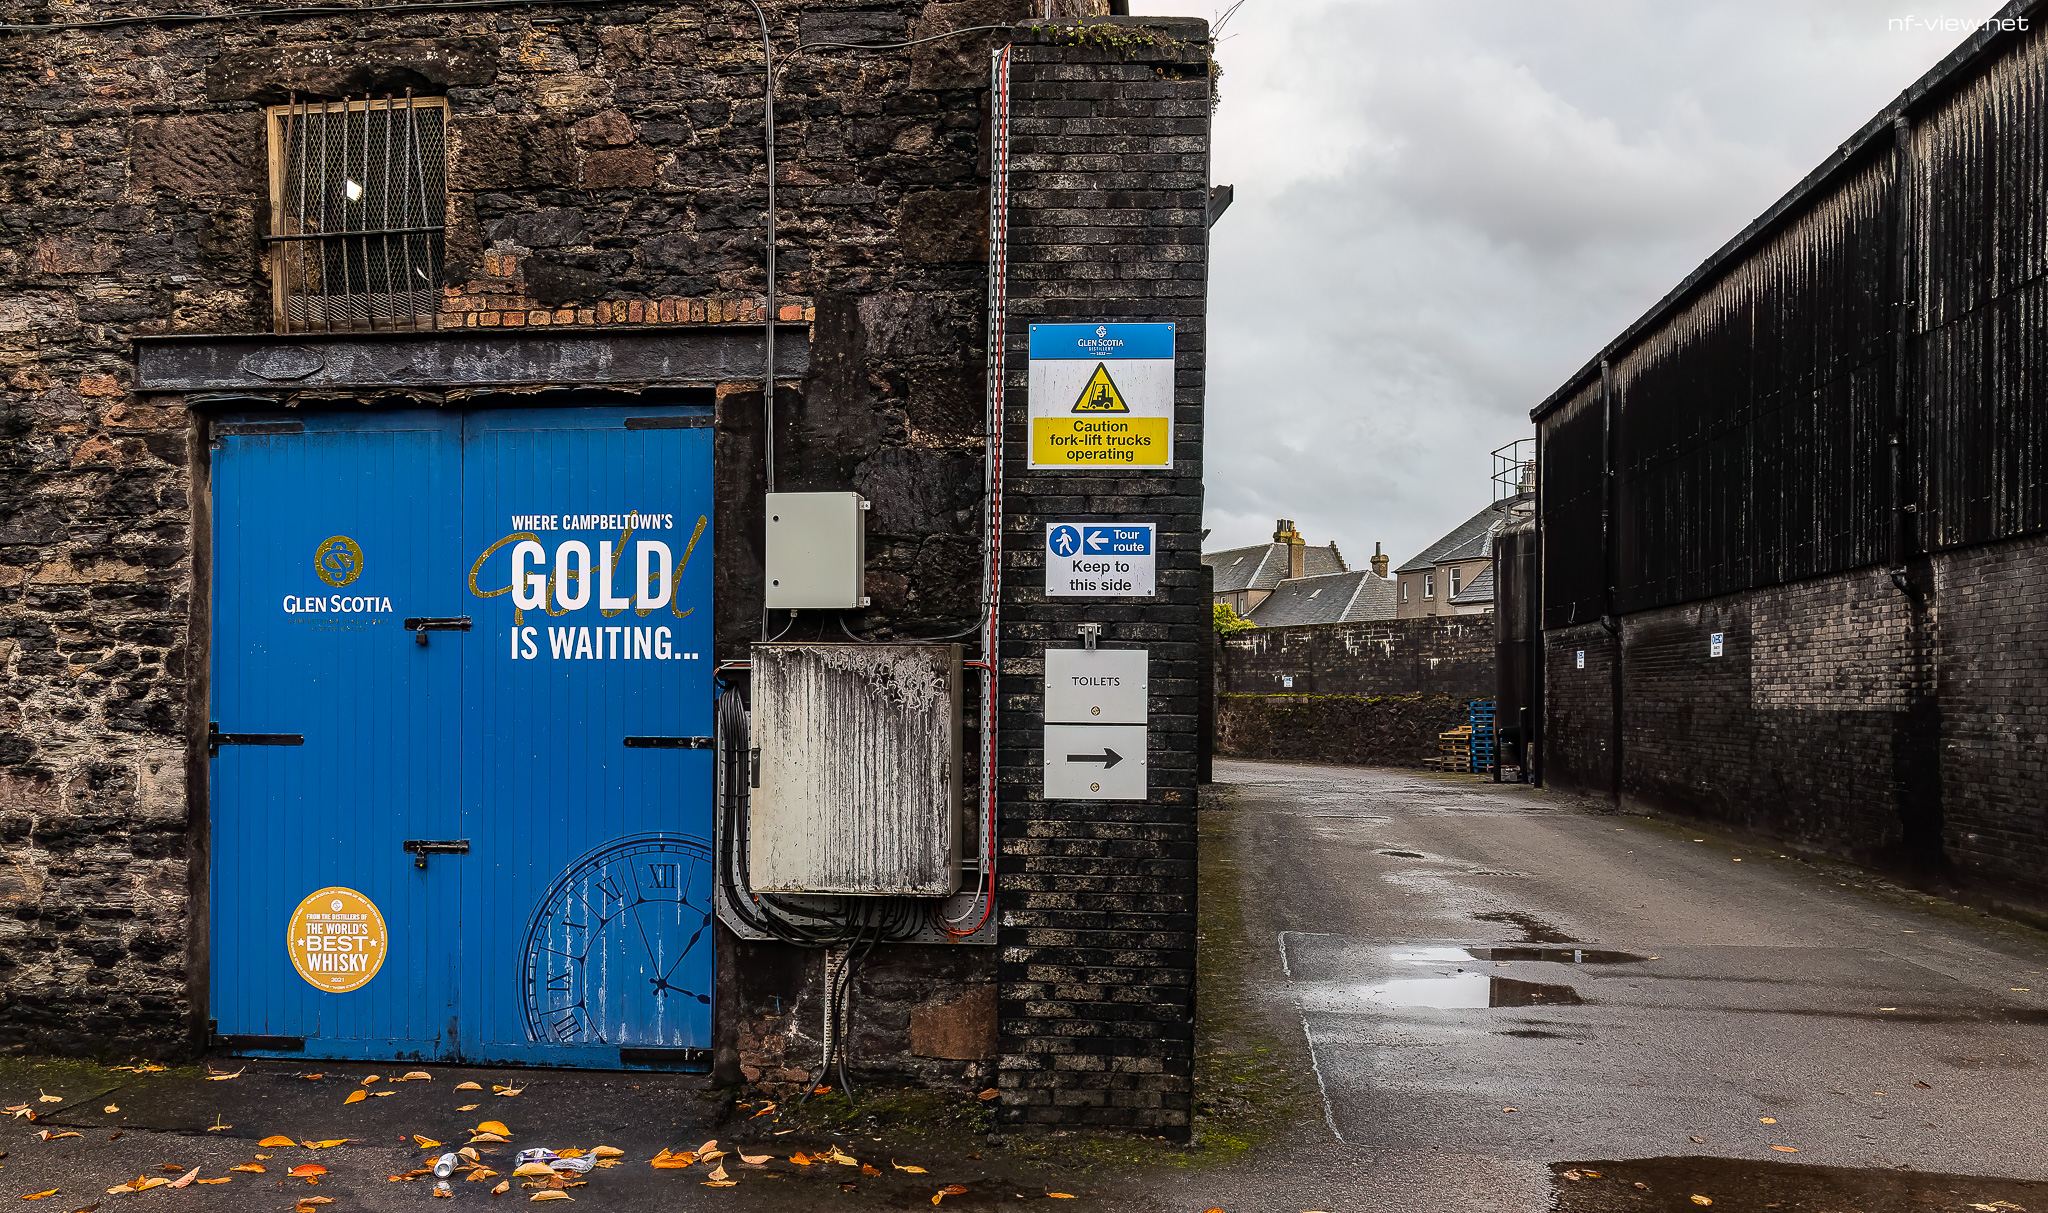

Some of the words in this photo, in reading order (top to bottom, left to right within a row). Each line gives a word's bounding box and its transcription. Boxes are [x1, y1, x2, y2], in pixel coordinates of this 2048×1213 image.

[1077, 338, 1097, 347] GLEN
[1098, 338, 1124, 347] SCOTIA
[1073, 420, 1128, 432] Caution
[1050, 434, 1103, 446] fork-lift
[1106, 434, 1151, 446] trucks
[1066, 448, 1134, 462] operating
[511, 514, 559, 531] WHERE
[562, 513, 674, 531] CAMPBELTOWN'S
[1113, 529, 1140, 540] Tour
[1113, 542, 1145, 552] route
[1072, 560, 1110, 574] Keep
[1114, 560, 1130, 573] to
[511, 540, 673, 611] GOLD
[1069, 579, 1096, 591] this
[1100, 579, 1132, 592] side
[283, 594, 327, 615] GLEN
[330, 594, 394, 613] SCOTIA
[511, 626, 538, 660] IS
[548, 626, 699, 660] WAITING...
[1071, 676, 1121, 687] TOILETS
[306, 923, 323, 934] THE
[326, 923, 368, 935] WORLD'S
[306, 935, 369, 952] BEST
[306, 953, 369, 972] WHISKY
